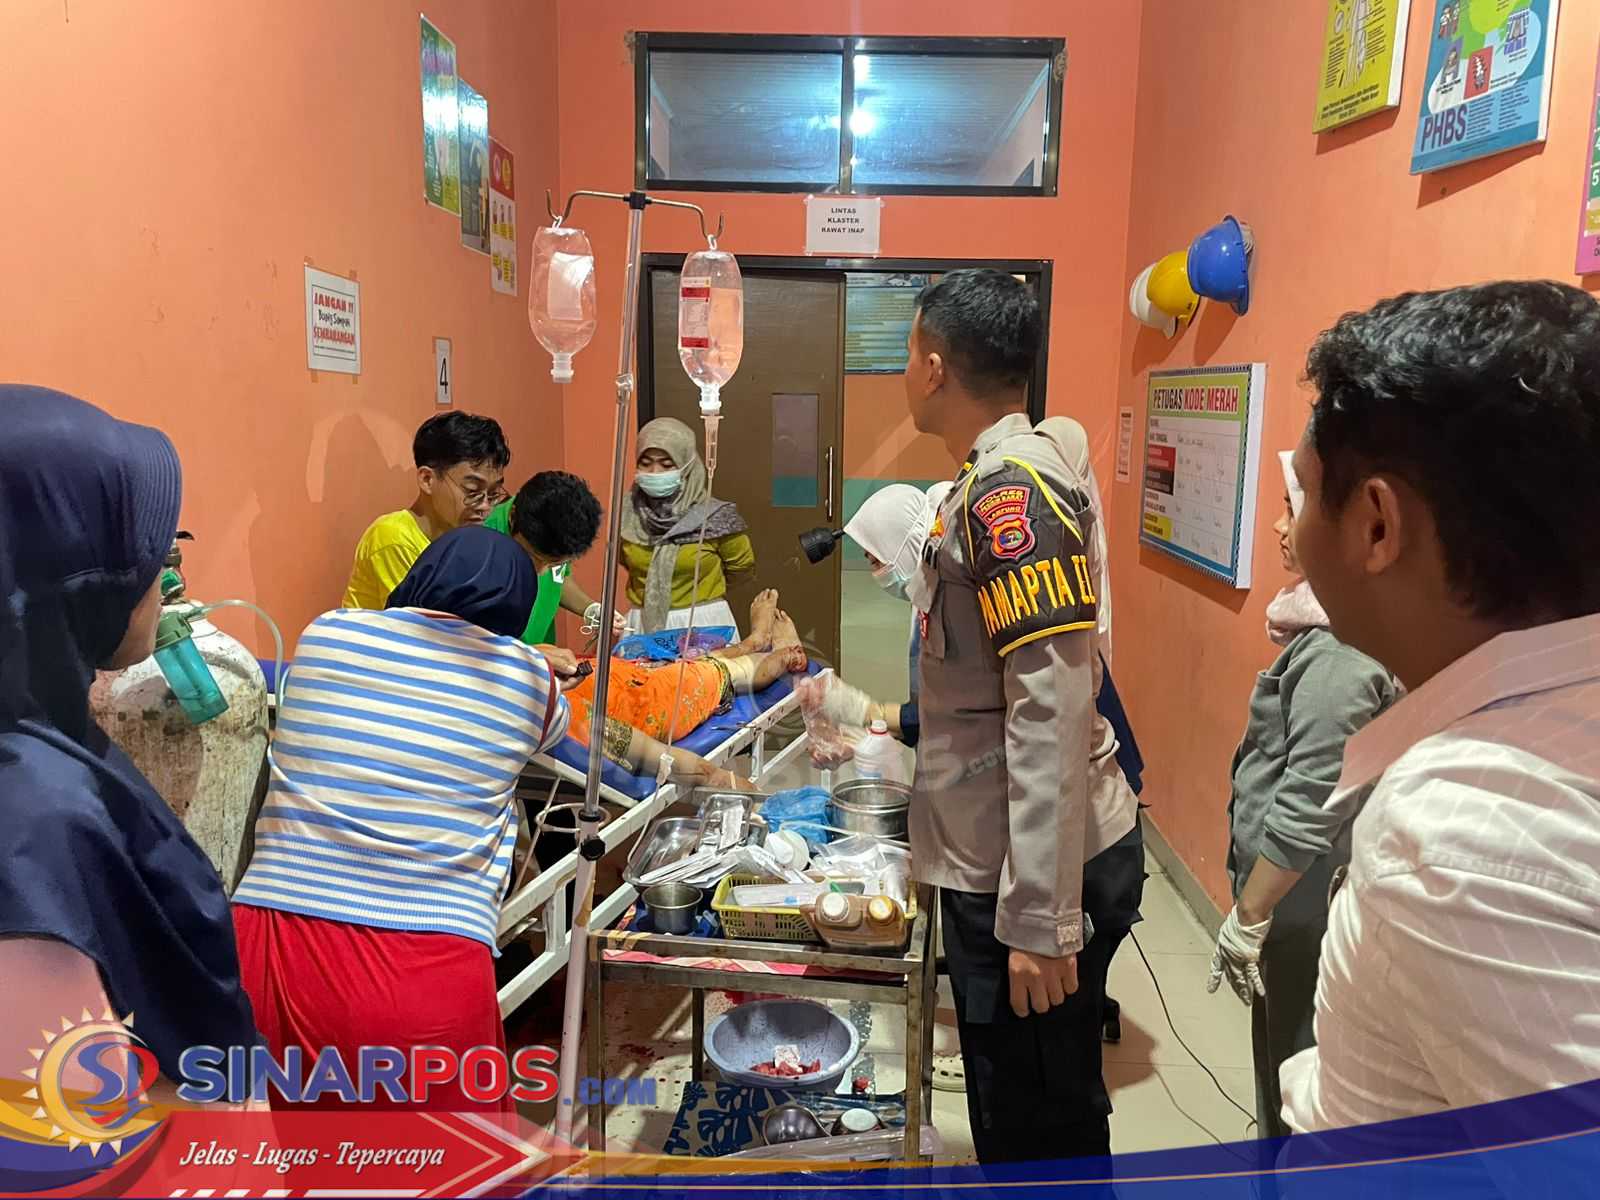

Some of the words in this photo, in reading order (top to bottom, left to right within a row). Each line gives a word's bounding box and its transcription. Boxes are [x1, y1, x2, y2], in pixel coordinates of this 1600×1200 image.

[1421, 103, 1468, 152] PHBS
[314, 293, 346, 313] JANGAN
[313, 326, 355, 345] SEMBARANGAN
[440, 357, 449, 395] 4
[1153, 388, 1183, 410] PETUGAS
[1184, 388, 1205, 410] KODE
[1206, 387, 1239, 412] MERAH
